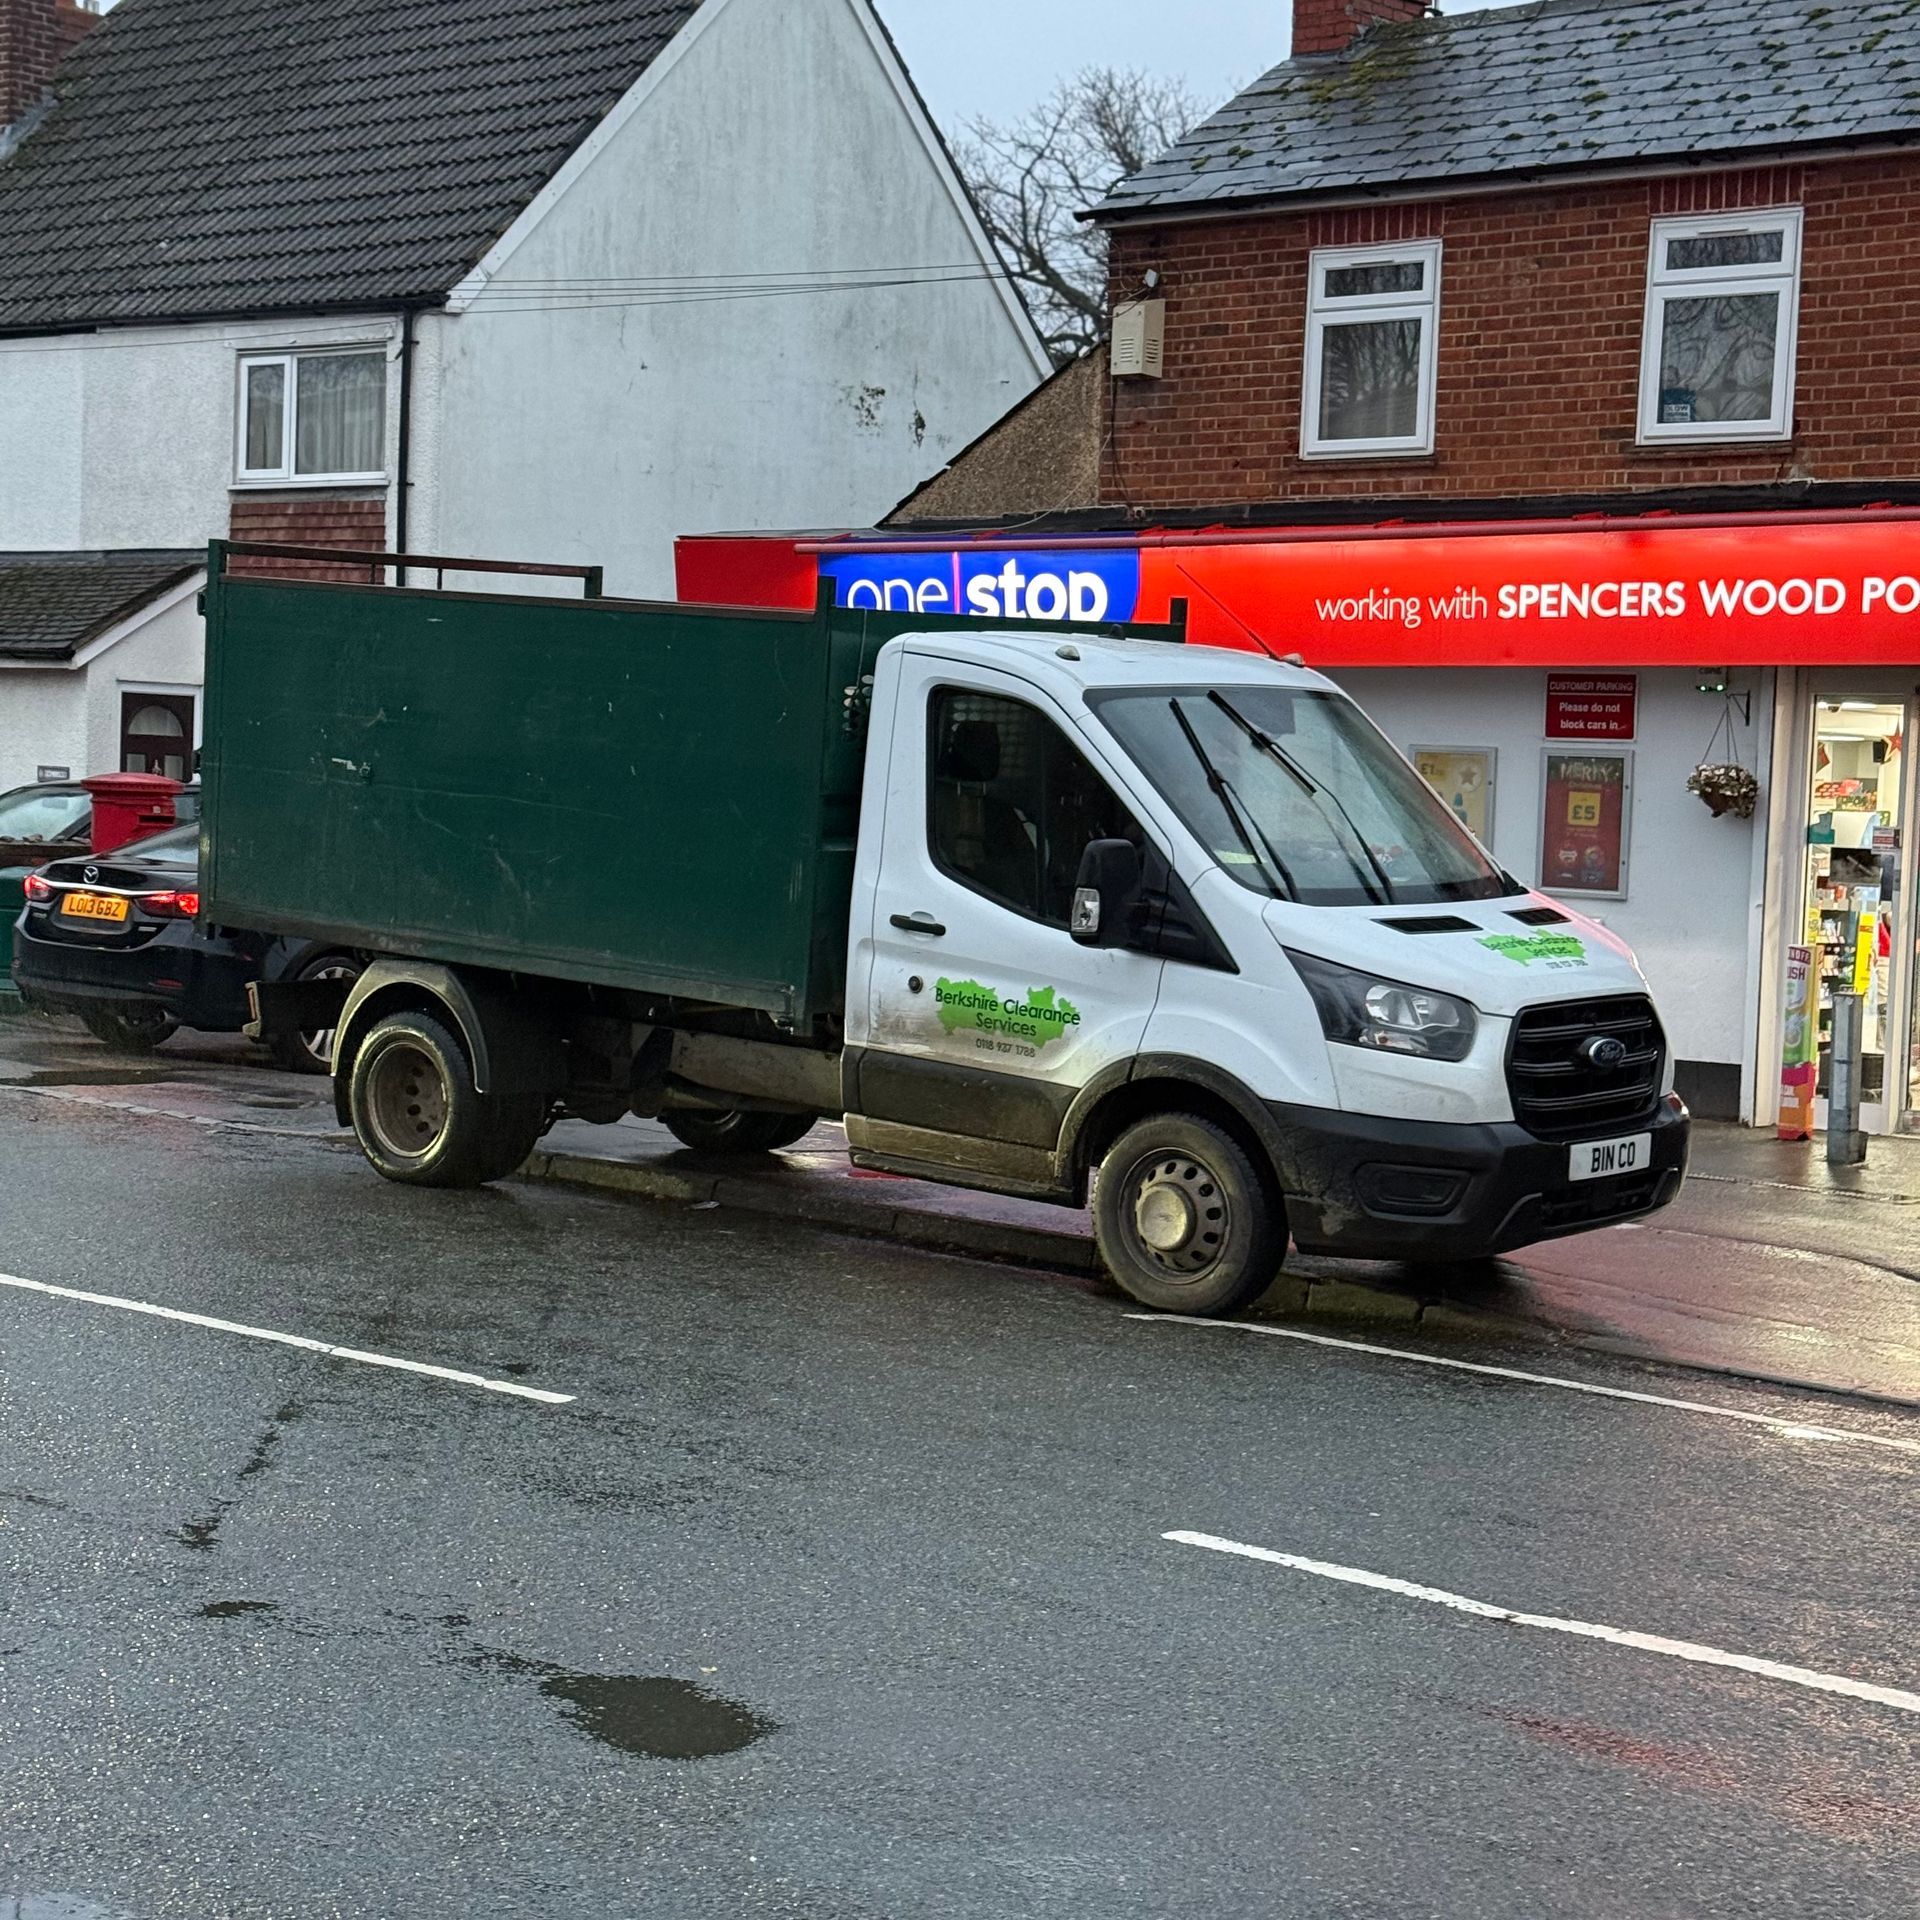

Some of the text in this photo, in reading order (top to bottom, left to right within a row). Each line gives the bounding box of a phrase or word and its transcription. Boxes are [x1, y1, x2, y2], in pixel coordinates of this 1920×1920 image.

[847, 558, 1108, 622] one stop
[1315, 575, 1920, 629] working with SPENCERS WOOD PO
[1550, 681, 1634, 692] CUSTOMER PARKING
[1559, 702, 1621, 713] Please do not
[1560, 719, 1618, 730] block cars in
[1572, 804, 1596, 820] £5
[68, 898, 121, 917] LO13 GBZ
[935, 987, 1081, 1025] Berkshire Clearance
[975, 1012, 1037, 1037] Services
[975, 1038, 995, 1051] 0118
[1618, 1142, 1636, 1168] CO
